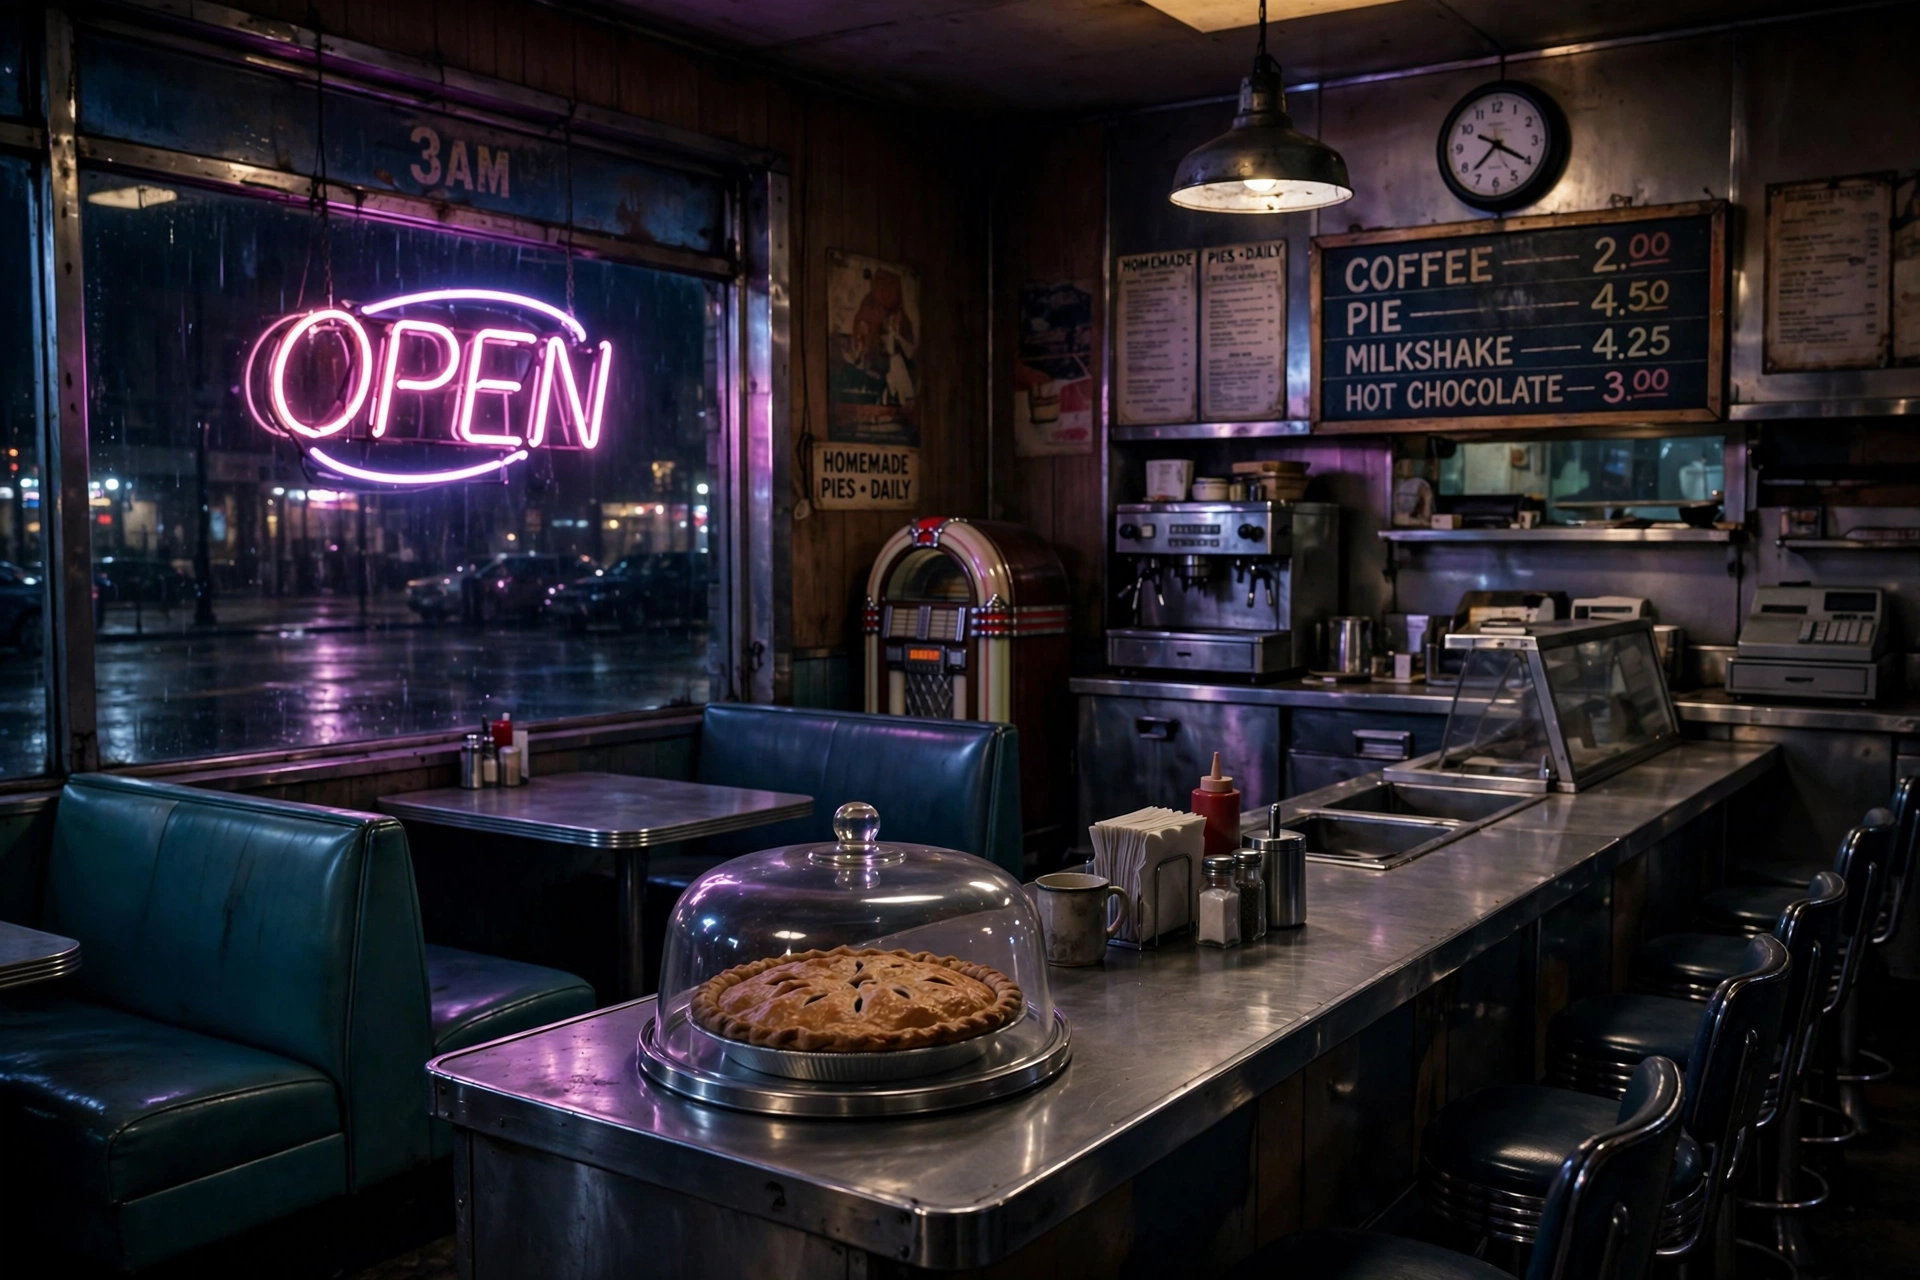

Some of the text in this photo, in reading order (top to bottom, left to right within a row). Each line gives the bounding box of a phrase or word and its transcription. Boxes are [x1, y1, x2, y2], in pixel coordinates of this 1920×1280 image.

[1492, 101, 1503, 113] 12
[1513, 104, 1517, 115] 1
[1476, 110, 1485, 120] 11
[1525, 116, 1533, 127] 2
[1462, 123, 1474, 135] 10
[1531, 135, 1538, 146] 3
[1455, 143, 1464, 154] 9
[410, 126, 511, 199] 3AM
[1461, 162, 1469, 173] 8
[1475, 173, 1482, 185] 7
[1510, 170, 1518, 181] 5
[1492, 177, 1500, 187] 6
[1208, 243, 1283, 264] PIES DAILY
[1122, 252, 1194, 272] HOMEMADE
[1344, 231, 1671, 294] COFFEE 2.00
[1346, 279, 1671, 337] PIE 4.50
[1344, 324, 1671, 376] MILKSHAKE 4.25
[269, 308, 613, 451] OPEN
[1345, 367, 1671, 413] HOT CHOCOLATE 3.00
[823, 451, 909, 475] HOMEMADE
[821, 477, 912, 500] PIES DAILY
